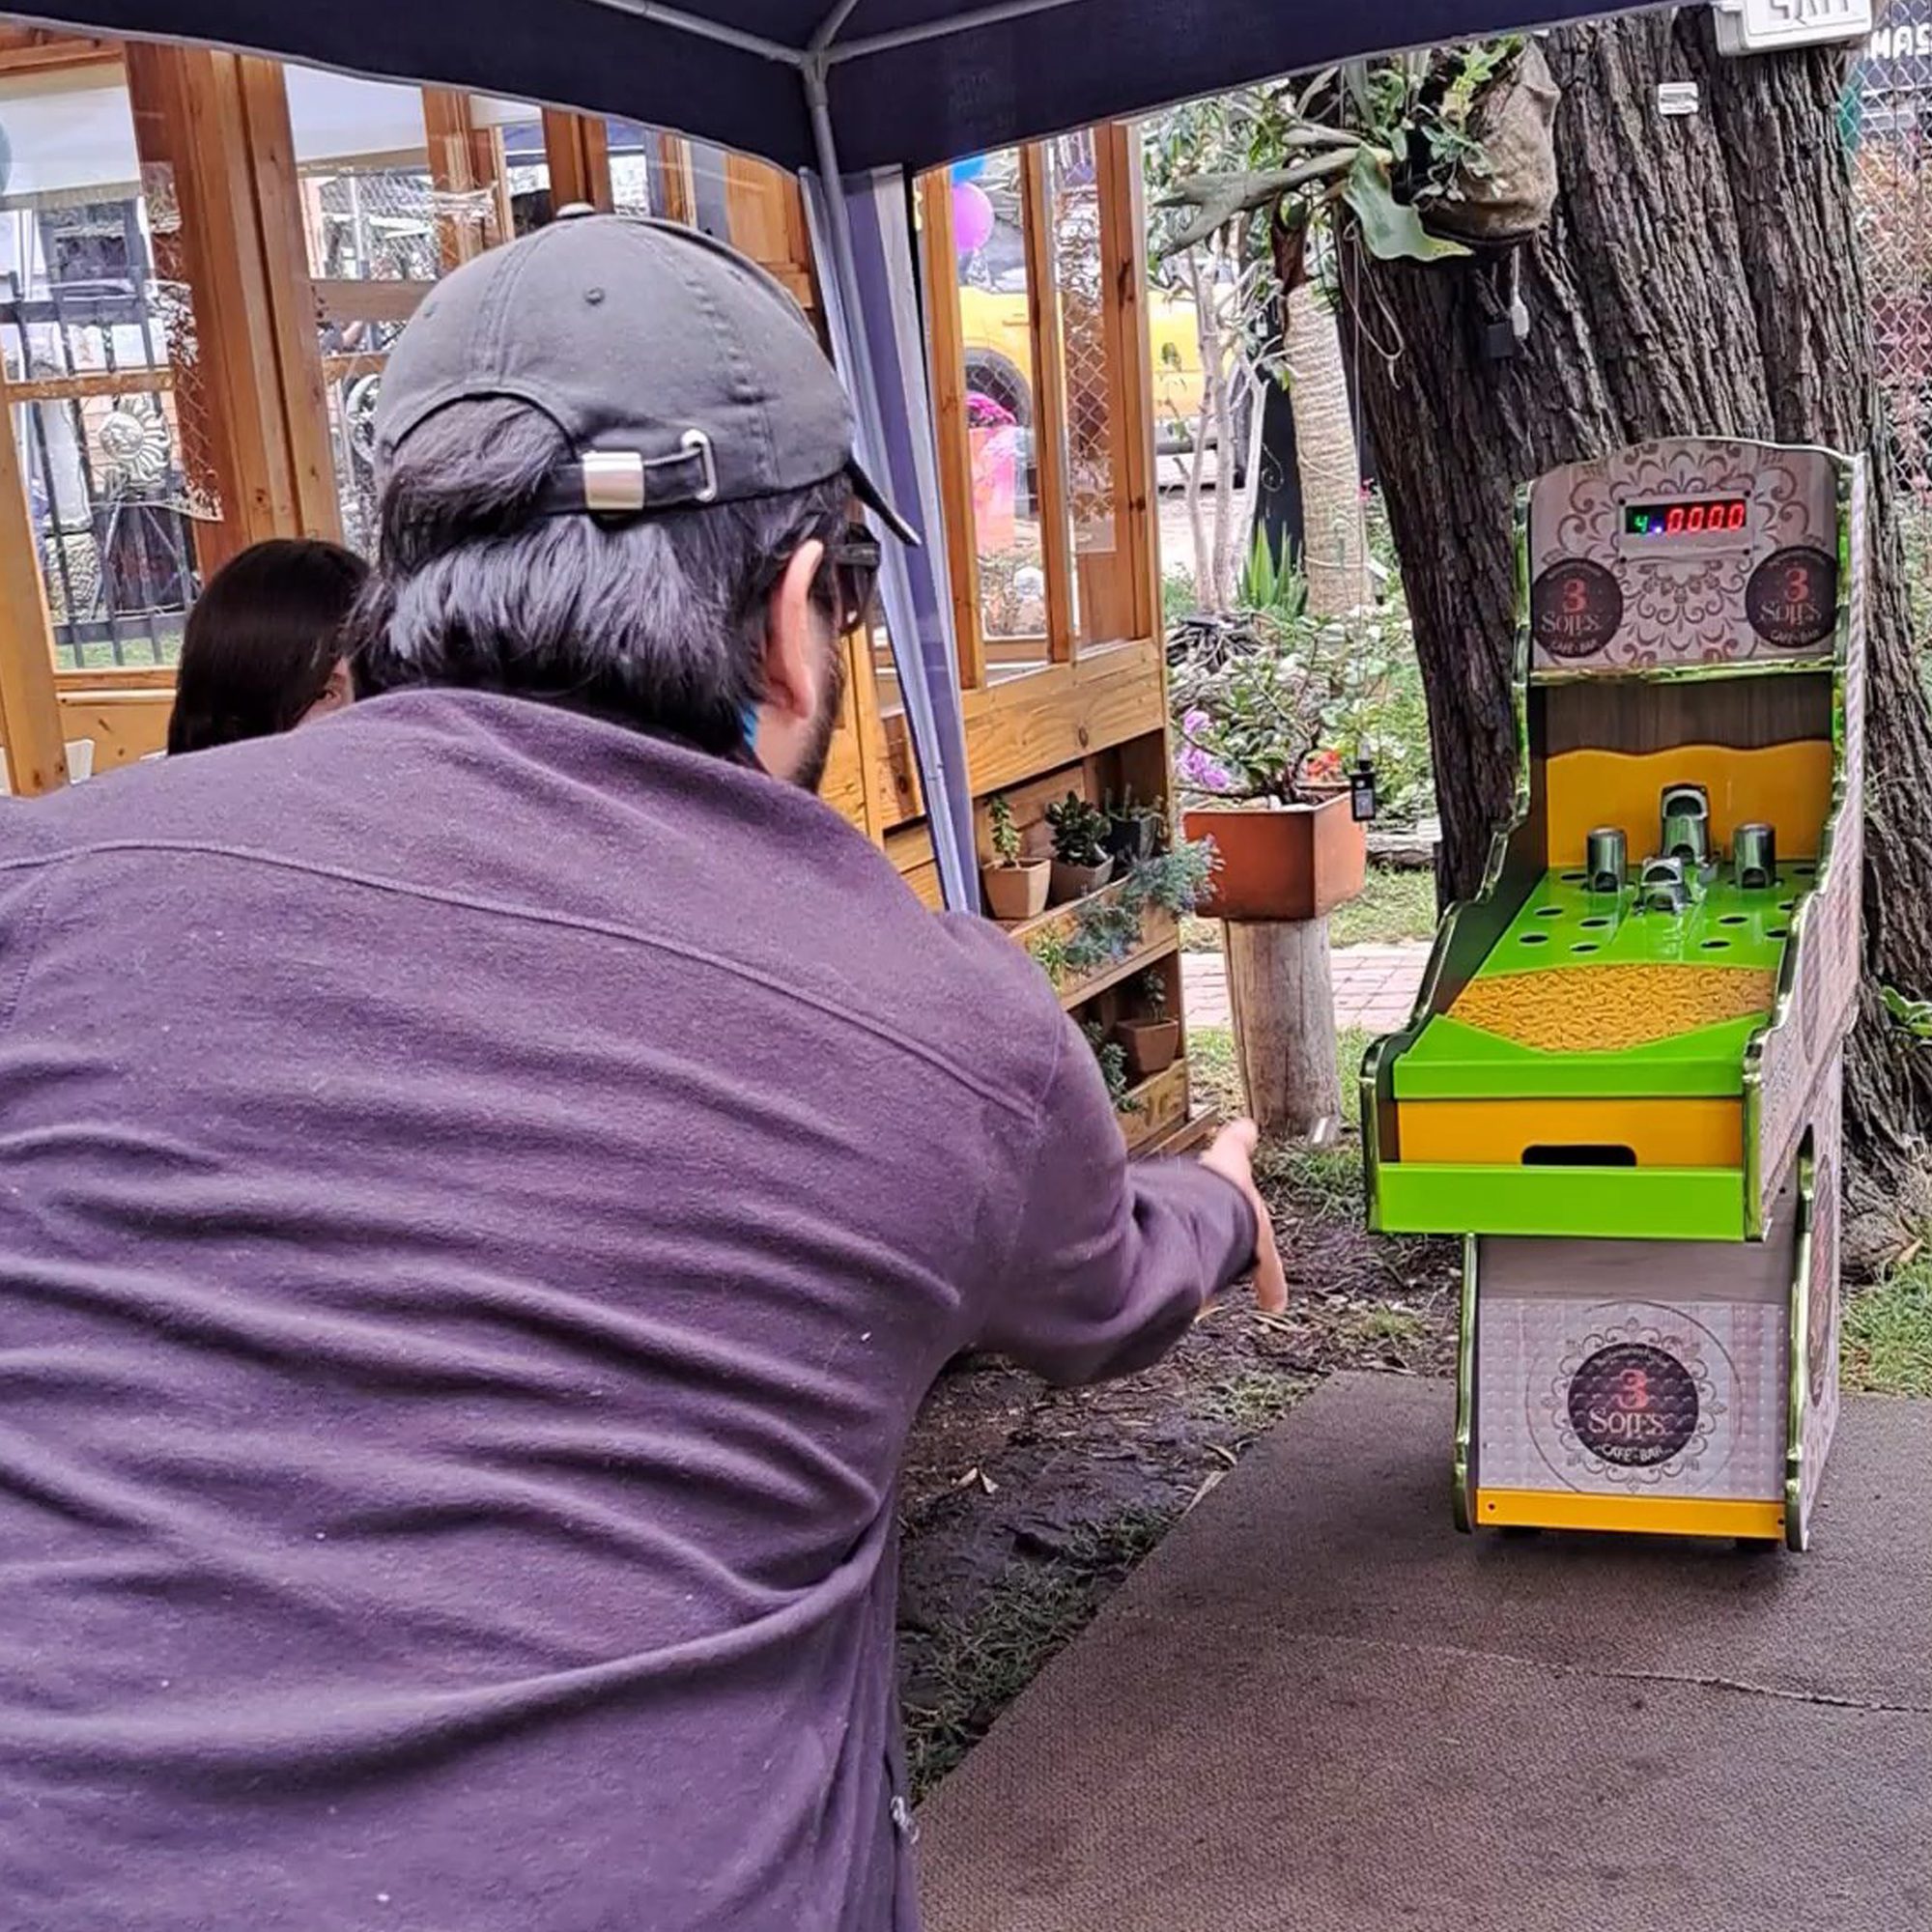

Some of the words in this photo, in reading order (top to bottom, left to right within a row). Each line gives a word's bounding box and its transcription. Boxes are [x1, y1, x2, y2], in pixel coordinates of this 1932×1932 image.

[1562, 579, 1588, 612] 3
[1783, 568, 1809, 603] 3
[1618, 1369, 1649, 1409] 3
